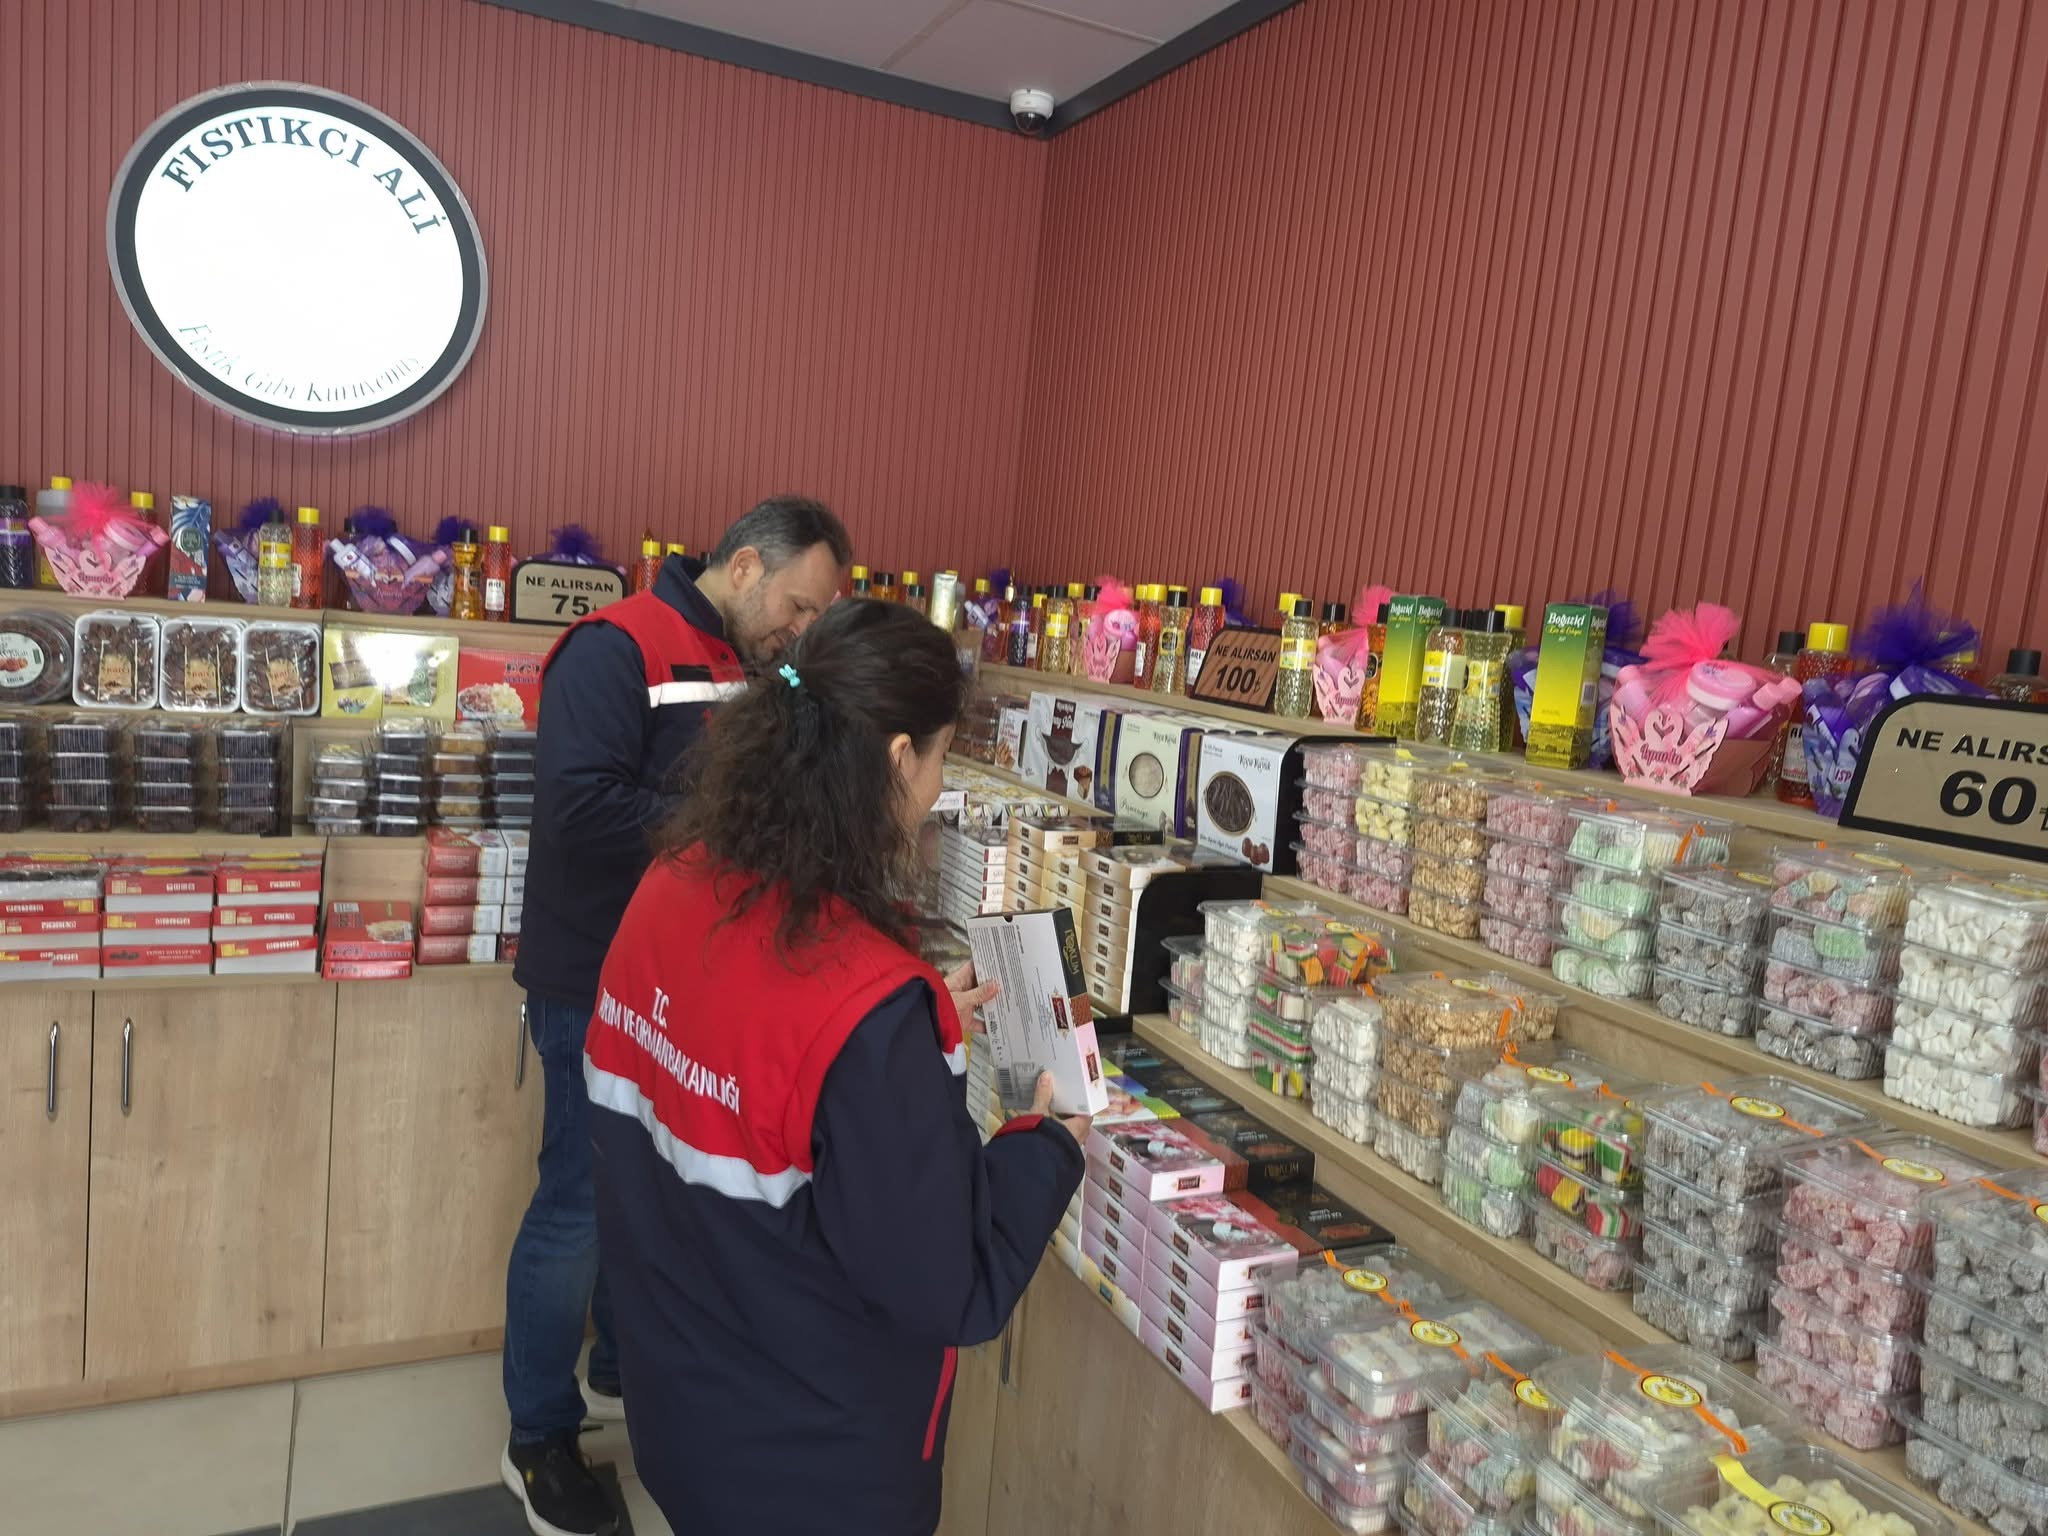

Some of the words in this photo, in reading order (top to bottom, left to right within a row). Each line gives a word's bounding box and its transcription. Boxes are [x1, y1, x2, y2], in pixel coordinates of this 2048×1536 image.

[161, 116, 369, 192] FISTIKÇI
[373, 167, 447, 234] ALİ
[526, 575, 546, 587] NE
[551, 578, 614, 593] ALIRSAN
[1215, 644, 1229, 657] NE
[1230, 647, 1277, 664] ALIRSAN
[1897, 727, 1944, 752] NE
